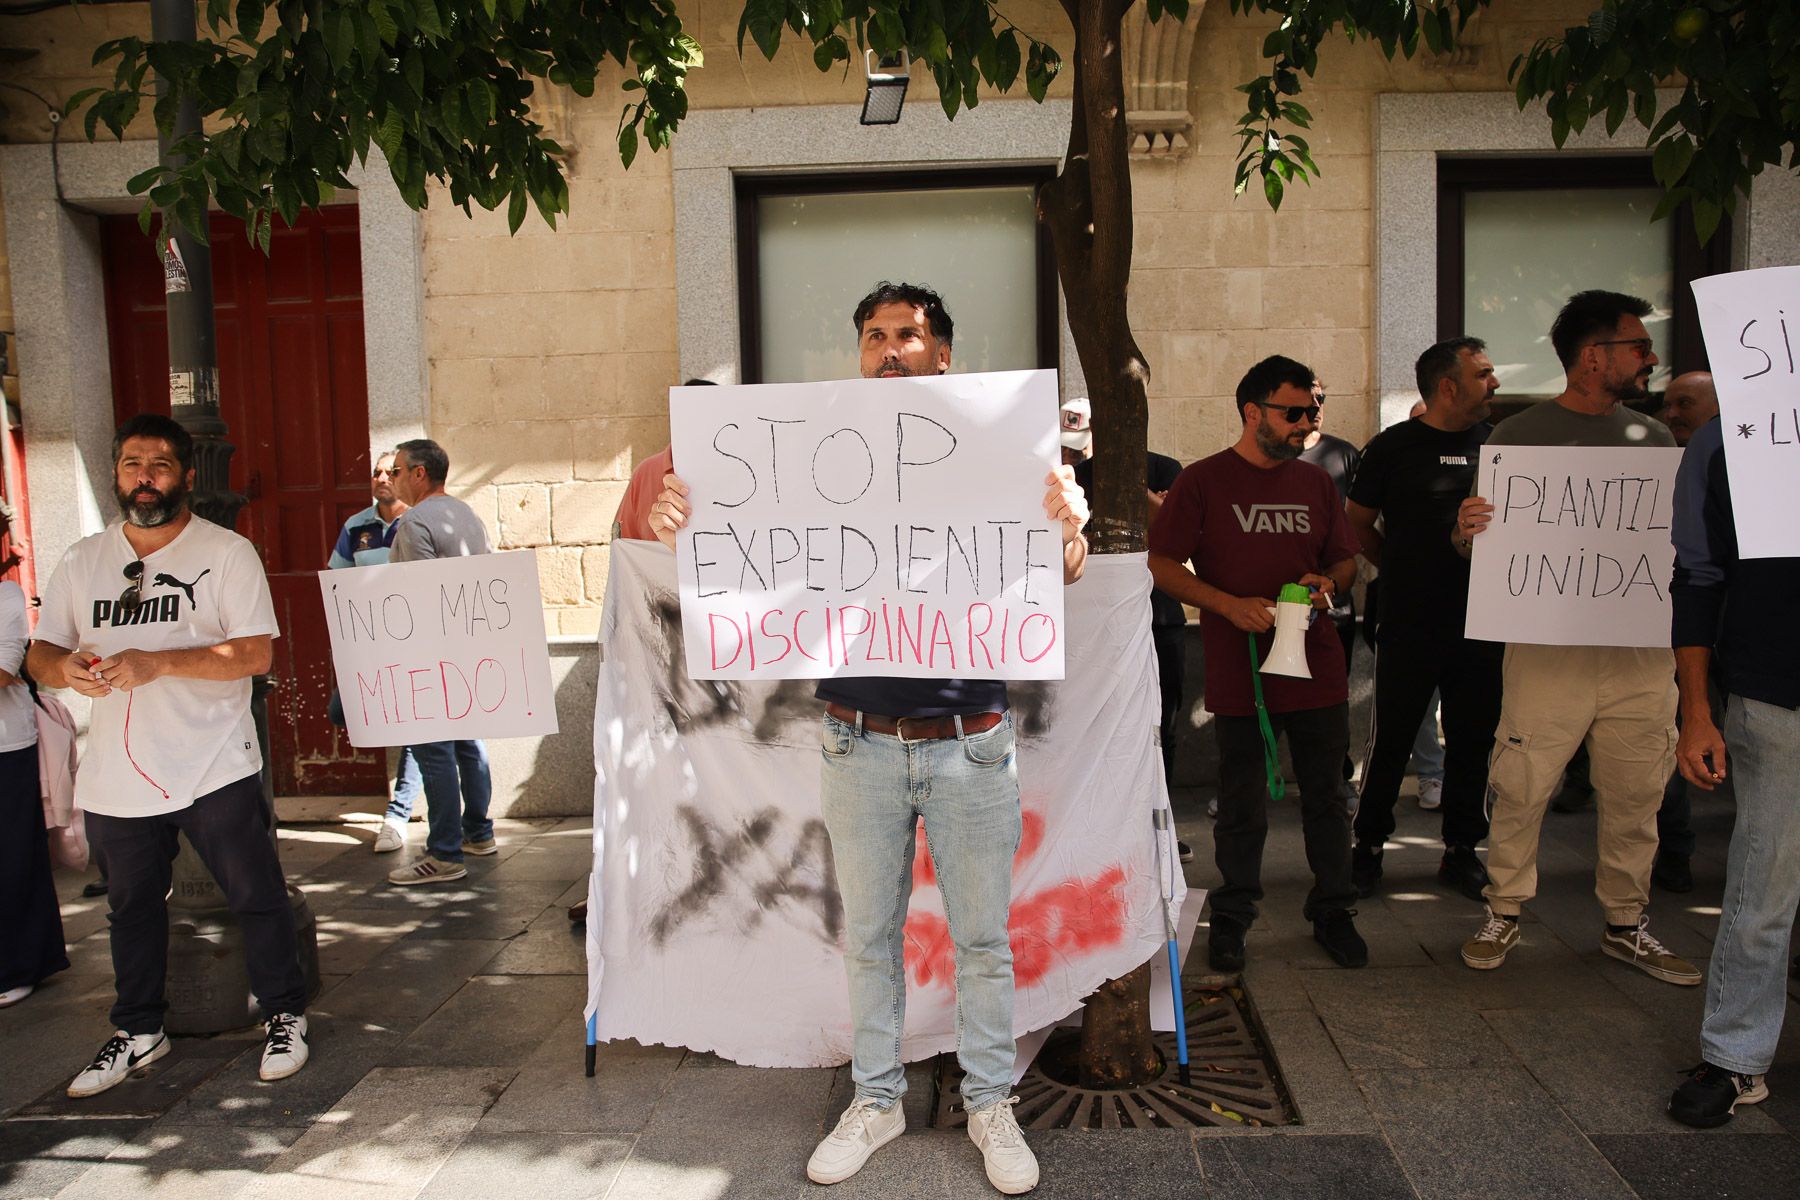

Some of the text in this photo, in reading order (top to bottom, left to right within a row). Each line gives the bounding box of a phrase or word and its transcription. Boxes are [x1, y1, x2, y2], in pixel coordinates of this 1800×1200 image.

[712, 411, 958, 508] STOP
[1439, 455, 1468, 465] PUMA
[1231, 503, 1312, 534] VANS
[692, 519, 1050, 606] EXPEDIENTE
[439, 577, 512, 637] MAS
[707, 597, 1057, 671] DISCIPLINARIO
[356, 646, 533, 727] MIEDO!
